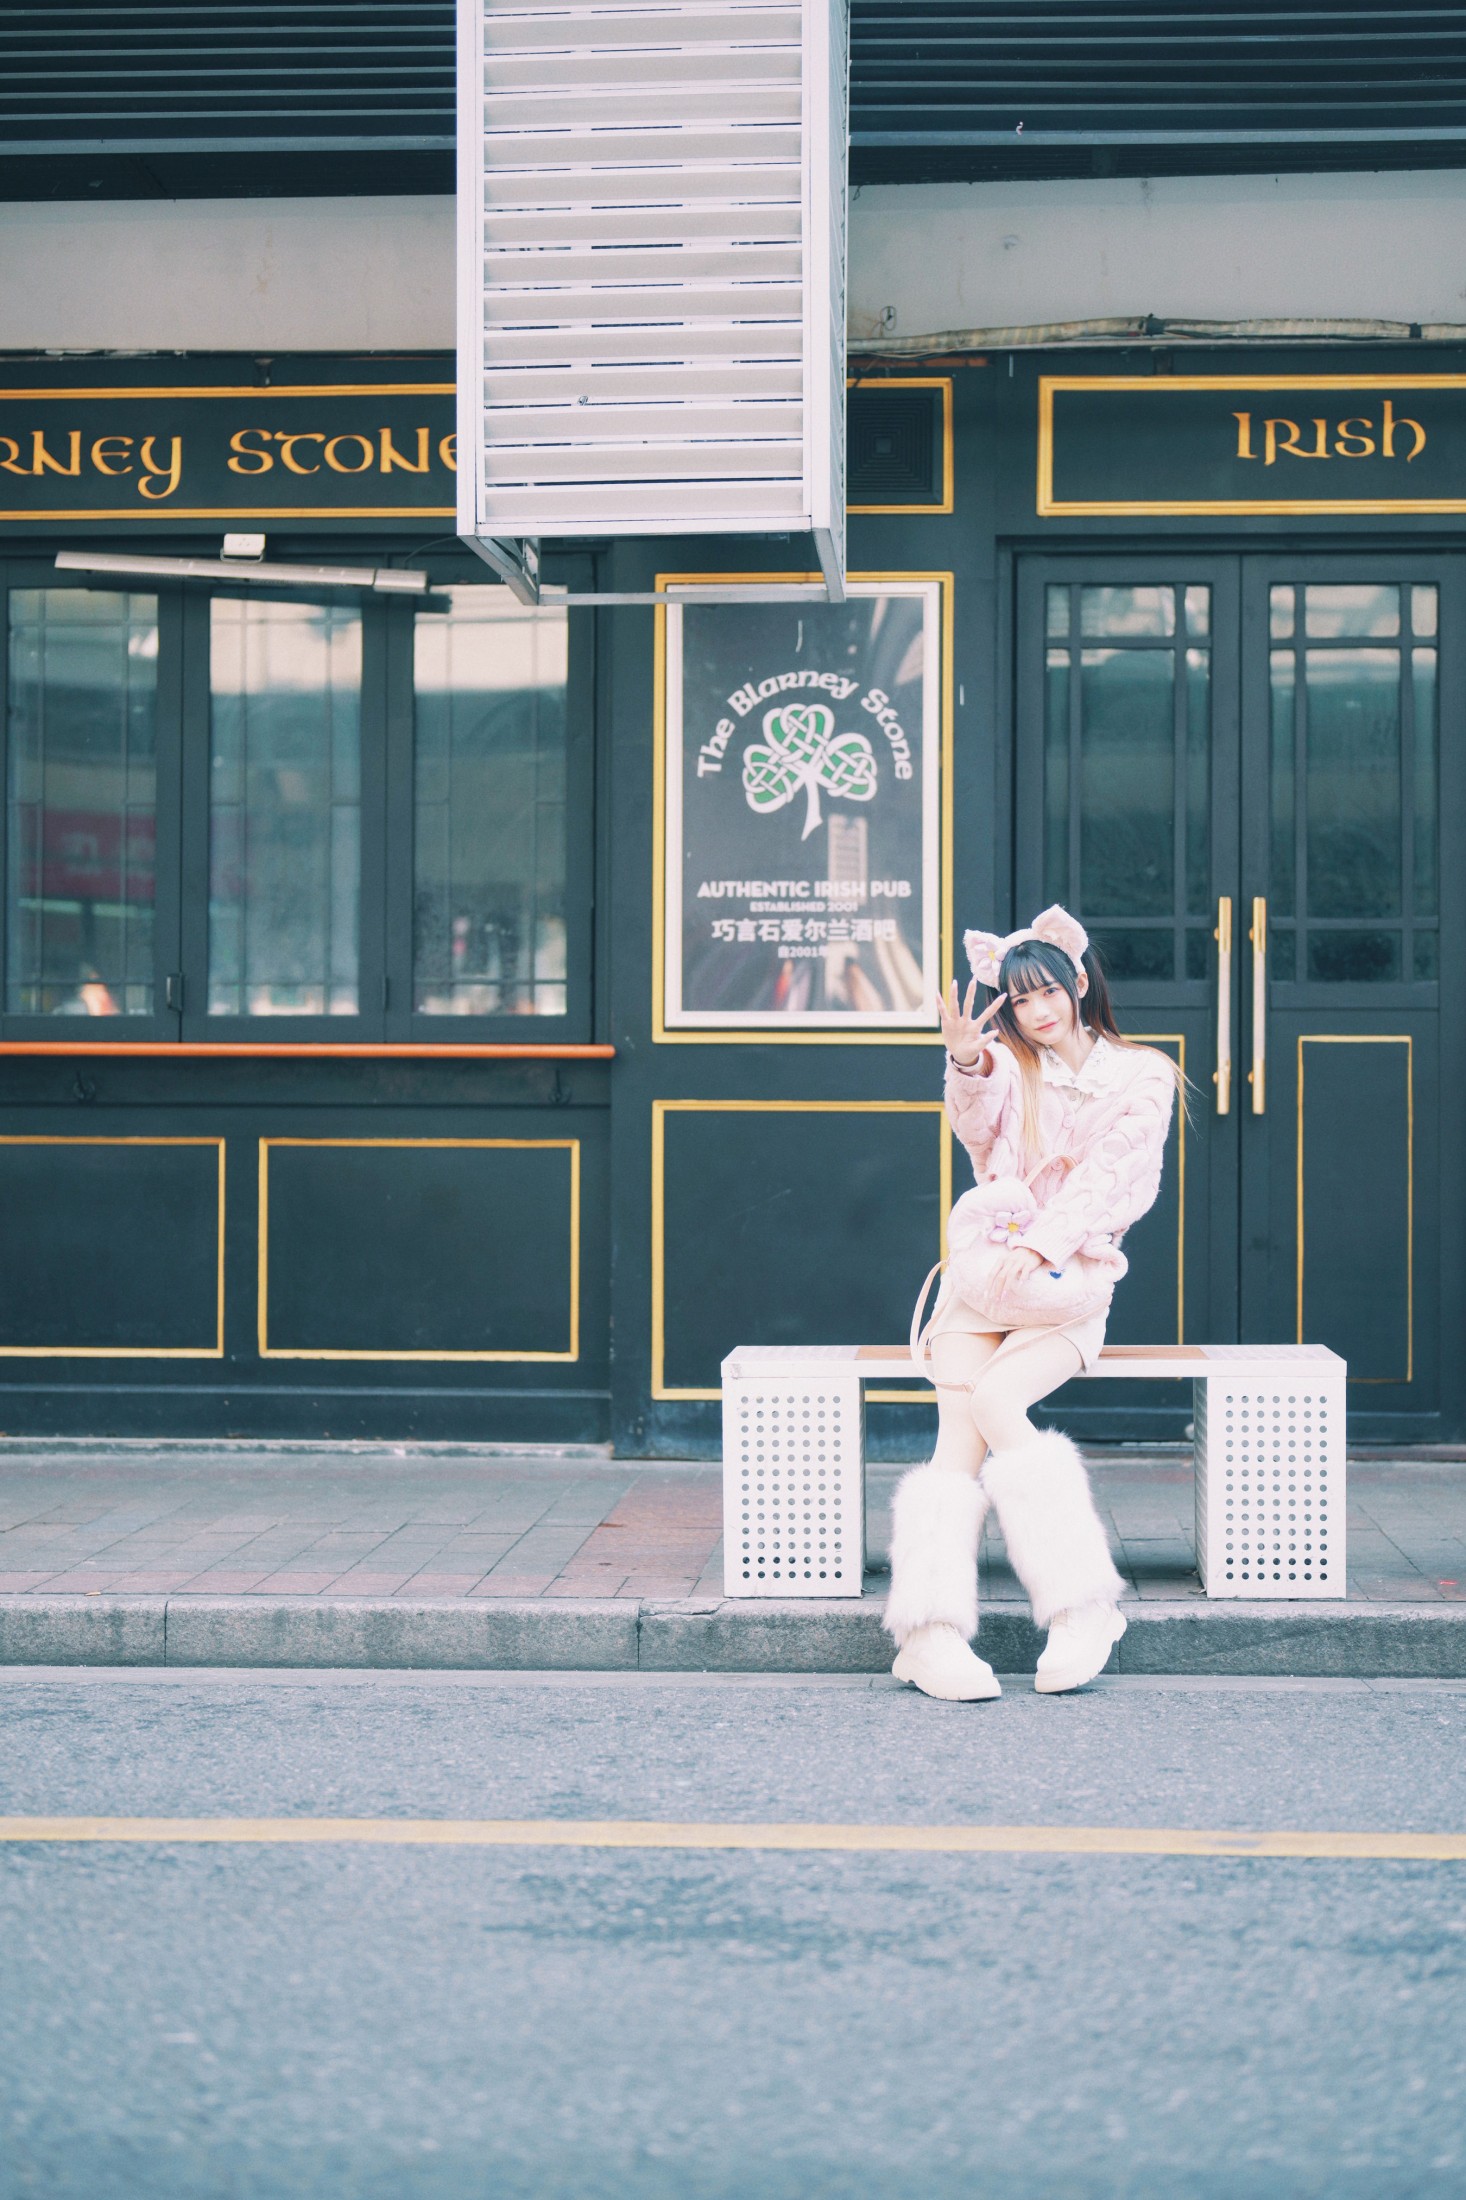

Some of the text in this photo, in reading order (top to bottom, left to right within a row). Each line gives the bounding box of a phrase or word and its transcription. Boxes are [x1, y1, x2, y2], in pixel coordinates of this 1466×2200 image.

[697, 671, 913, 780] The Blarney Stone
[697, 881, 912, 898] AUTHENTIC IRISH PUB
[750, 902, 826, 912] ESTABLISHED
[711, 918, 897, 942] 巧言石爱尔兰酒吧
